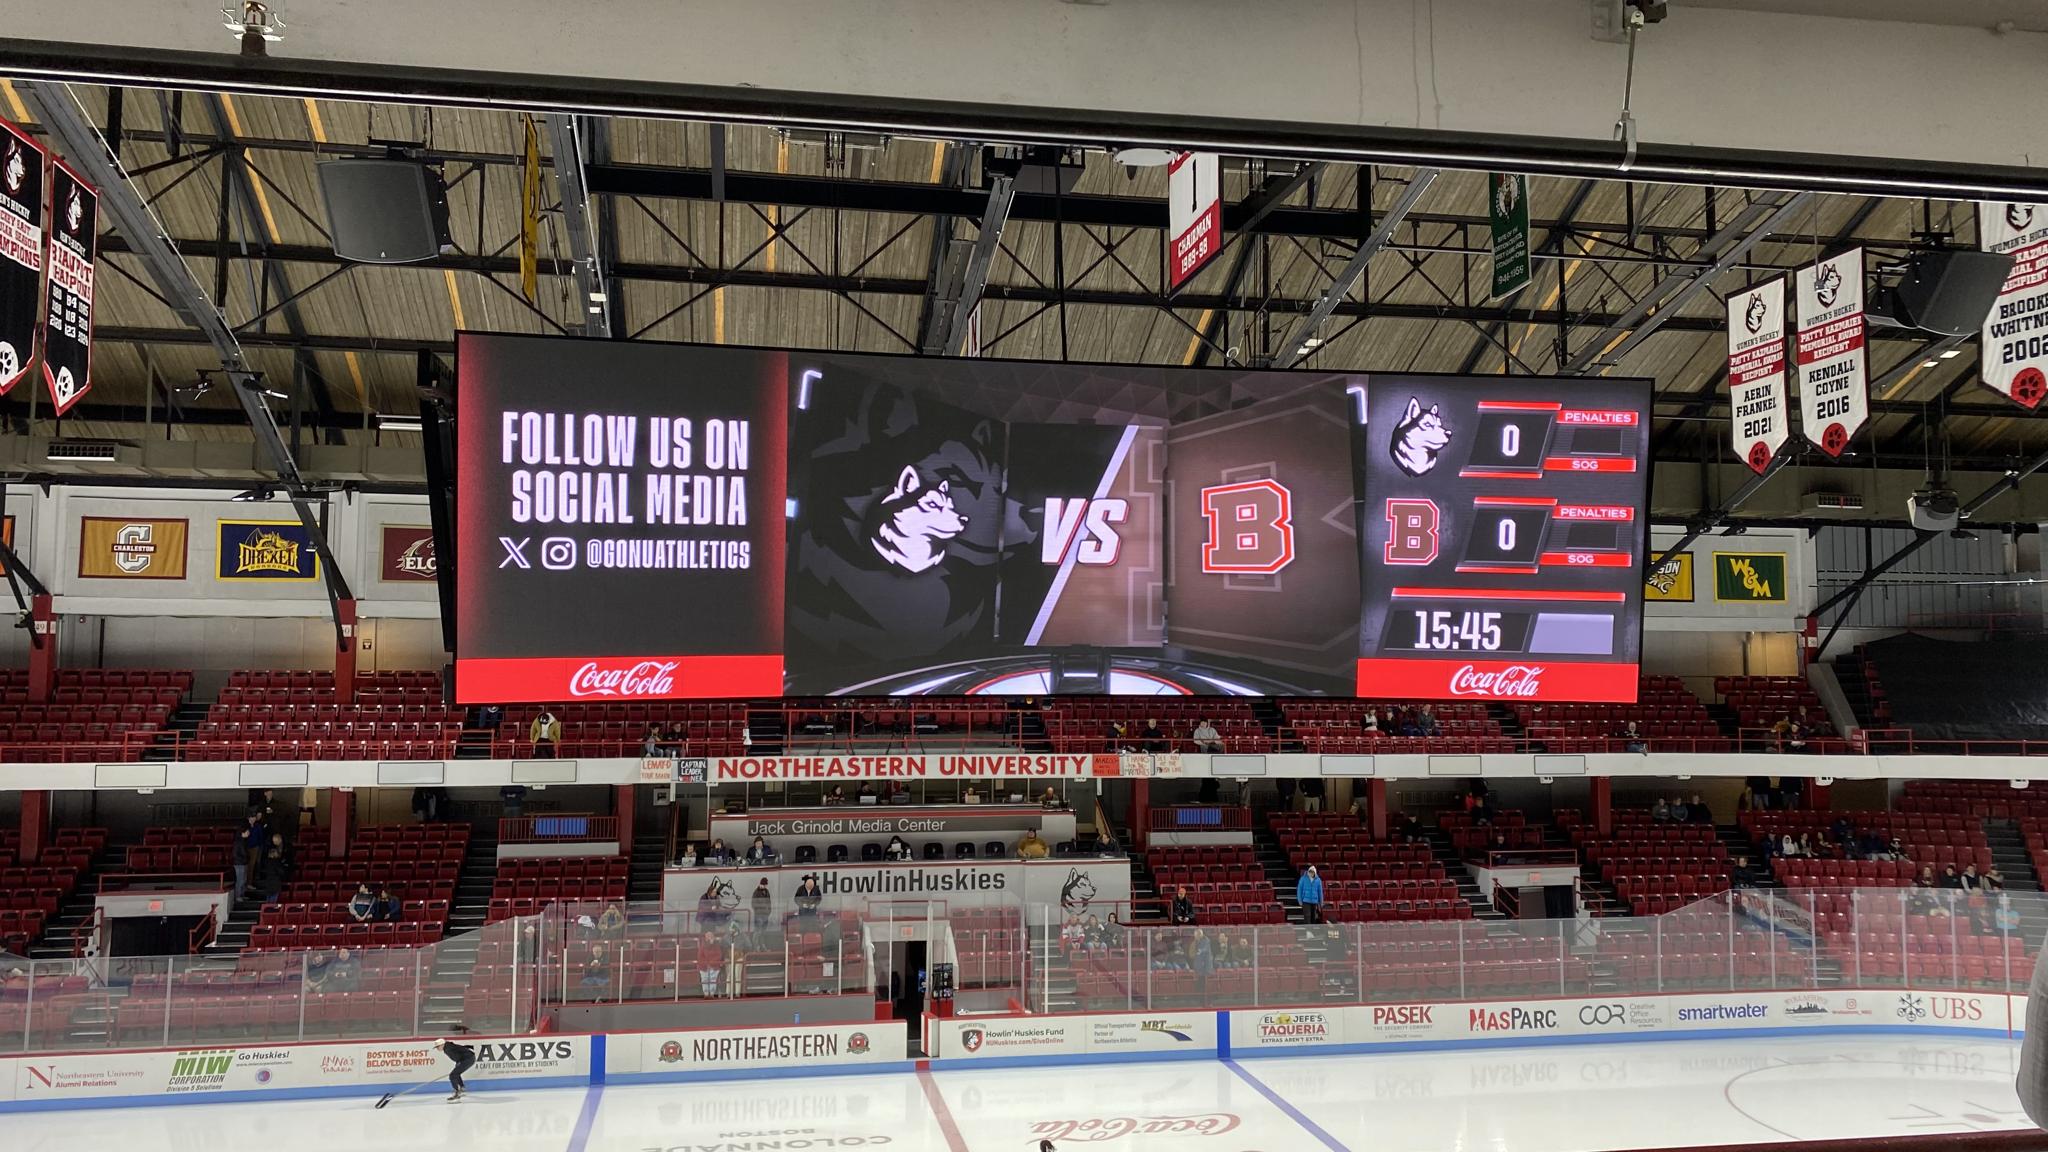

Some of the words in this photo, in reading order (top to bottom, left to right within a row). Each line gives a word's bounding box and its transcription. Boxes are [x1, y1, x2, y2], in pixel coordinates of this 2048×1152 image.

[1808, 359, 1855, 384] KENDALL
[1743, 384, 1772, 402] AERIN
[1815, 376, 1849, 397] COYNE
[1564, 411, 1632, 424] PENALTIES
[1736, 397, 1777, 418] FRANKEL
[1817, 395, 1850, 420] 2016
[1744, 416, 1772, 438] 2021
[502, 411, 637, 467] FOLLOW
[650, 416, 692, 469] US
[705, 418, 749, 470] ON
[1502, 424, 1520, 457] 0
[1572, 460, 1599, 470] SOG
[512, 470, 634, 523] SOCIAL
[646, 474, 747, 526] MEDIA
[1560, 507, 1628, 519] PENALTIES
[1041, 497, 1130, 567] VS
[1201, 478, 1295, 574] B
[1384, 498, 1440, 566] B
[1498, 518, 1516, 551] 0
[242, 547, 296, 568] DREXEL
[586, 538, 750, 569] @GONUATHLETICS
[1567, 554, 1595, 564] SOG
[1730, 558, 1772, 598] W&M
[1414, 610, 1502, 651] 15:45
[680, 760, 707, 769] CAPTAIN
[717, 755, 926, 779] NORTHEASTERN
[939, 755, 1088, 775] UNIVERSITY
[751, 821, 786, 835] Jack
[791, 819, 843, 834] Grinold
[849, 819, 892, 833] Media
[897, 818, 946, 833] Center
[1264, 1016, 1275, 1024] EL
[1292, 1014, 1323, 1023] JEFE'S
[1373, 1006, 1433, 1025] PASEK
[1678, 1003, 1768, 1021] smartwater
[1930, 997, 1983, 1021] UBS
[986, 1030, 1014, 1038] Howlin'
[1014, 1028, 1045, 1037] Huskies
[1045, 1028, 1064, 1036] Fund
[1261, 1024, 1326, 1036] TAQUERIA
[238, 1052, 251, 1061] Go
[252, 1050, 290, 1060] Huskies!
[366, 1051, 404, 1059] BOSTON'S
[406, 1049, 429, 1057] MOST
[693, 1033, 838, 1062] NORTHEASTERN
[171, 1055, 234, 1077] MIW
[366, 1059, 402, 1068] BELOVED
[404, 1058, 436, 1066] BURRITO
[56, 1072, 105, 1080] Northeastern
[107, 1070, 145, 1079] University
[168, 1074, 226, 1085] CORPORATION
[719, 1128, 816, 1139] BOSTON
